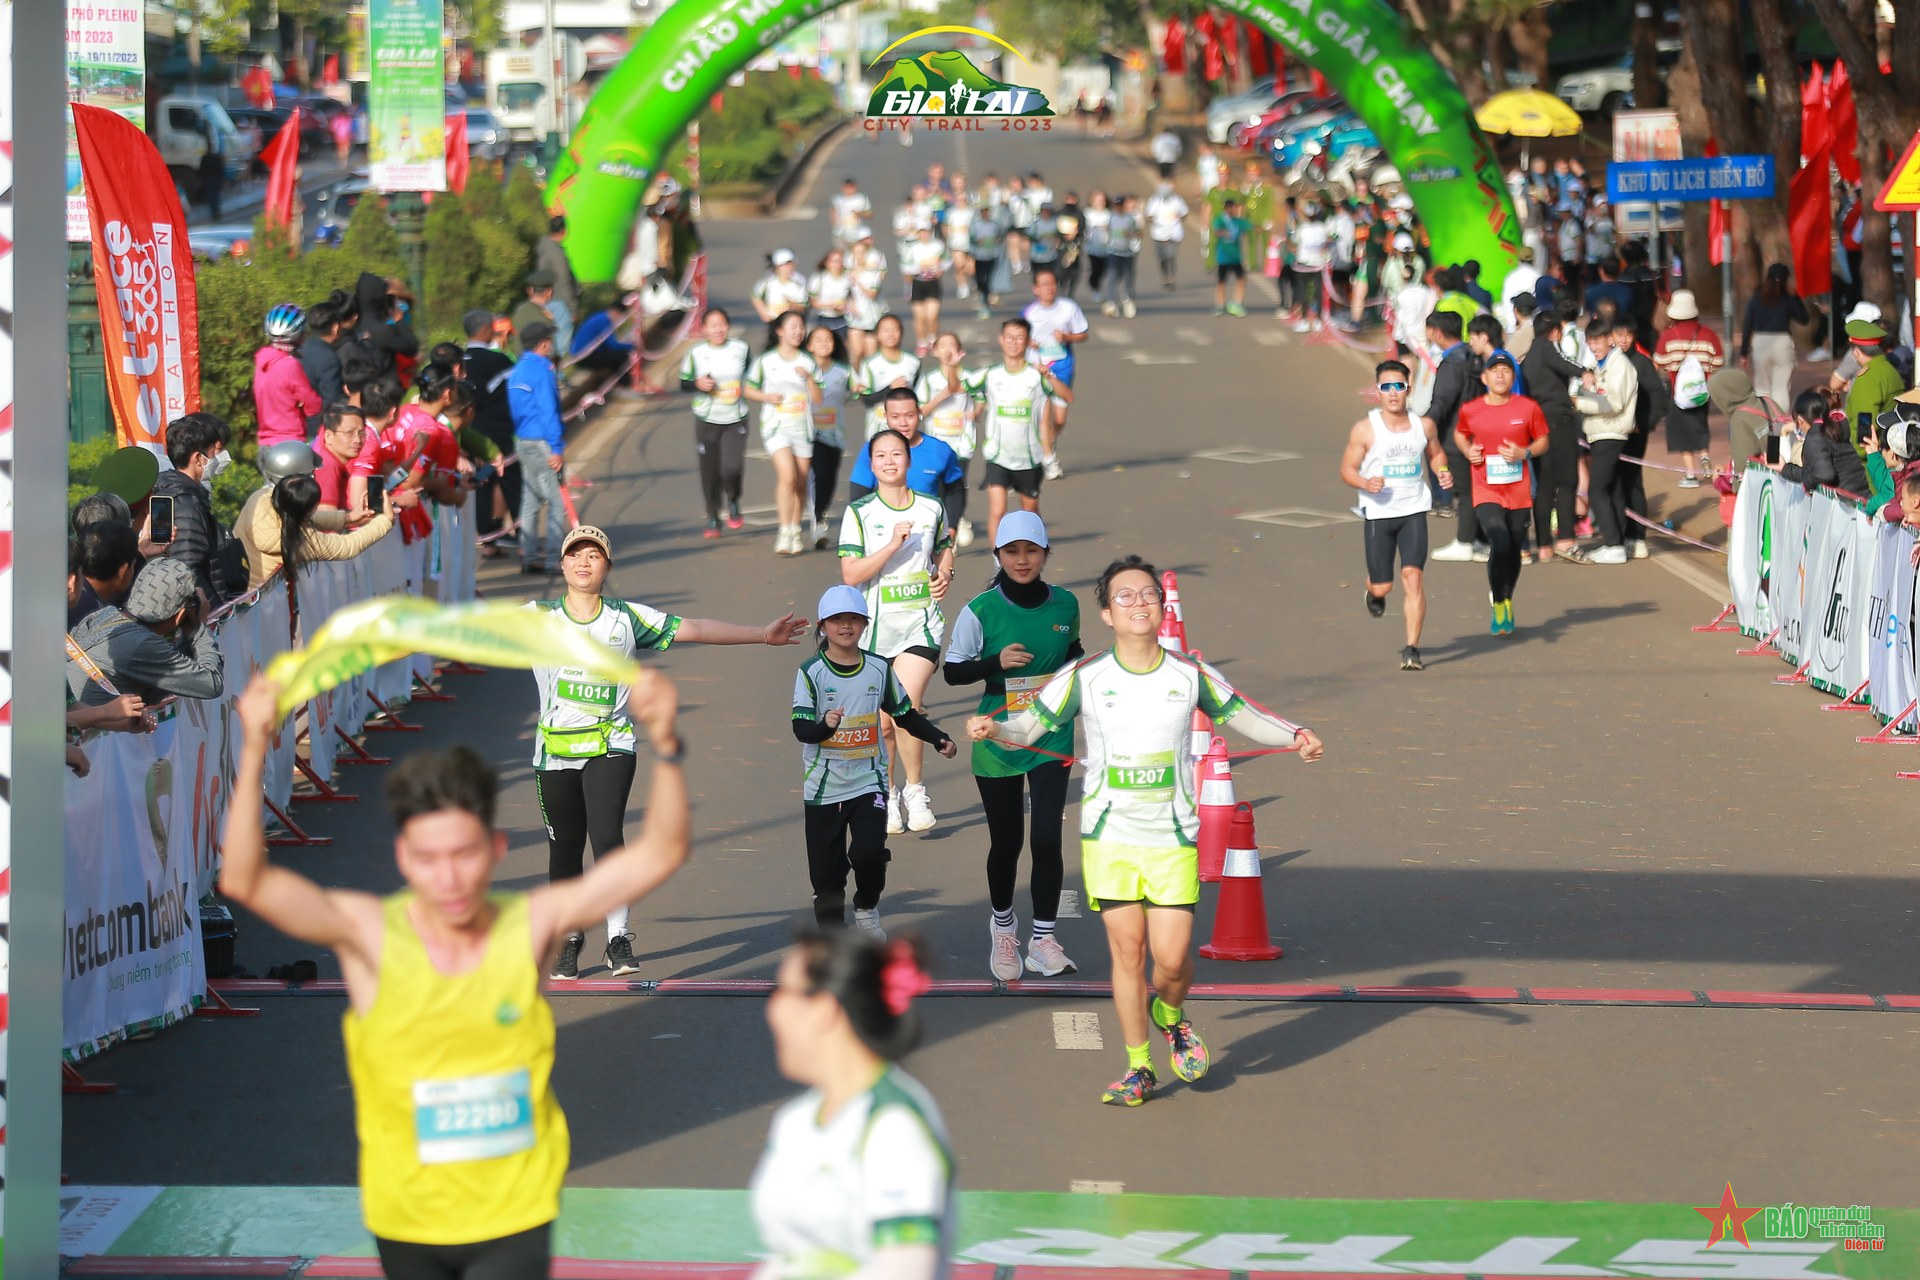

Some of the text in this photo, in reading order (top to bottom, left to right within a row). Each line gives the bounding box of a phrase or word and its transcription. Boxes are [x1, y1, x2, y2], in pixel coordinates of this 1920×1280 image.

[72, 3, 137, 22] PHỐ PLEIKU
[85, 30, 113, 43] 2023
[69, 52, 79, 61] 17
[88, 52, 138, 63] 19/11/2023
[1316, 10, 1380, 66] GIẢI
[1373, 65, 1441, 137] CHẠY
[1618, 155, 1767, 194] KHU DU LỊCH BIỂN HỒ
[156, 231, 182, 410] RATHON
[889, 584, 923, 598] 11067
[568, 683, 610, 700] 11014
[1117, 768, 1166, 784] 11207
[62, 868, 193, 980] ietcombank
[950, 1227, 1852, 1280] STAR
